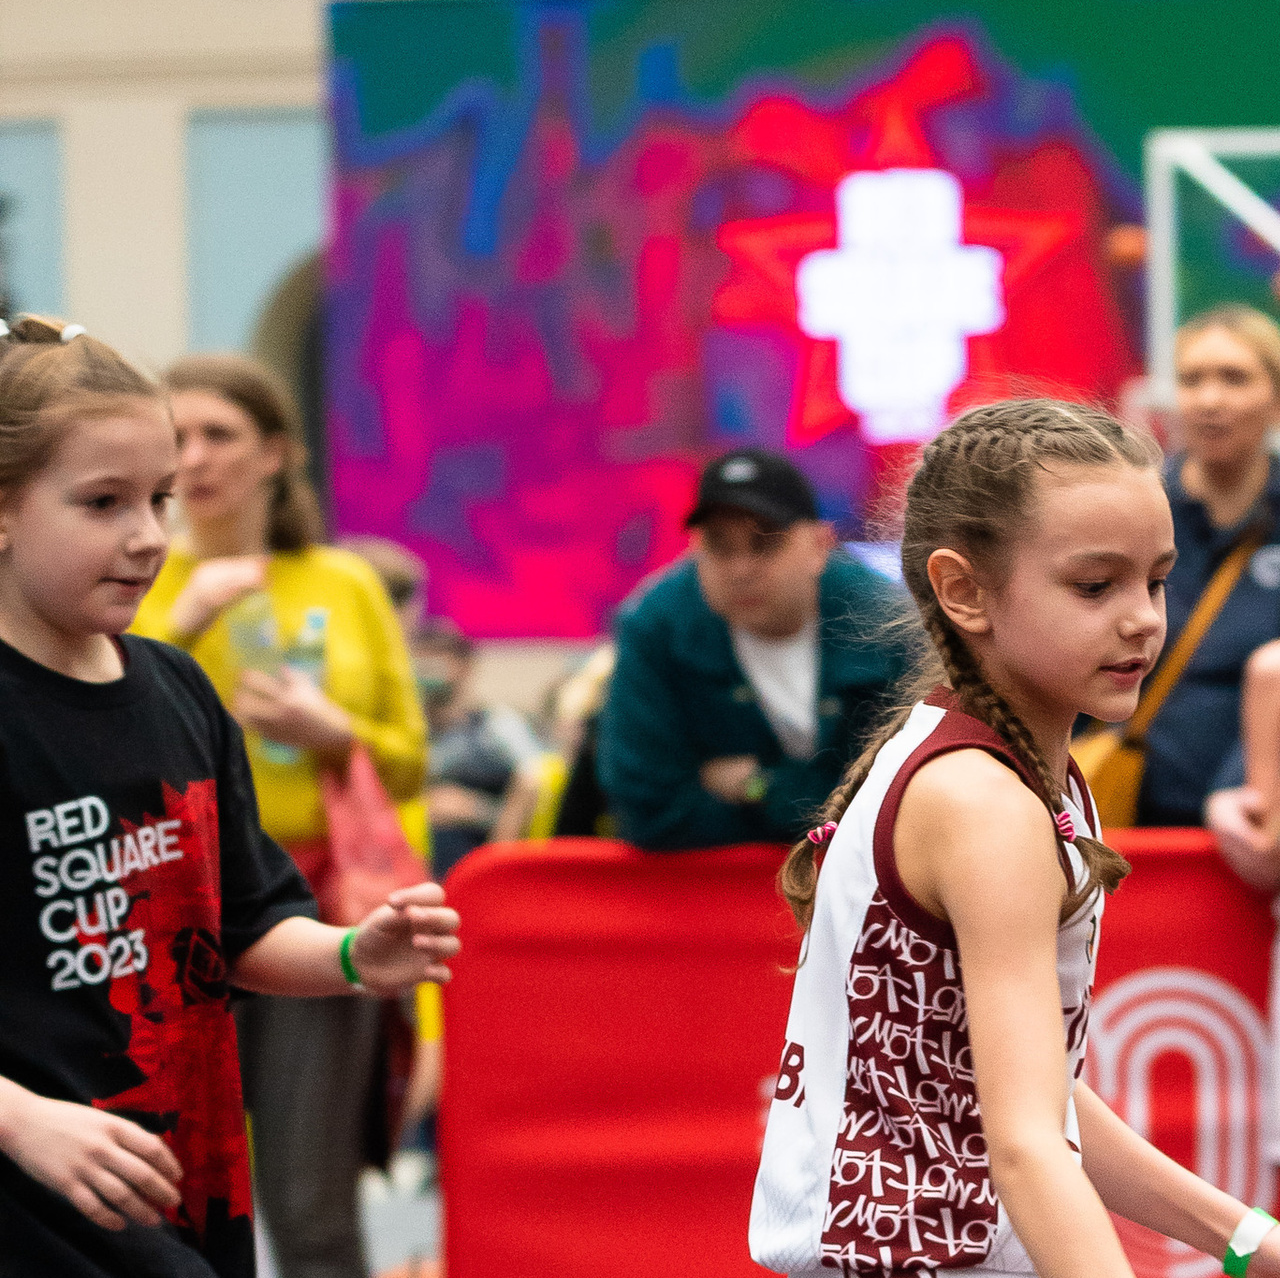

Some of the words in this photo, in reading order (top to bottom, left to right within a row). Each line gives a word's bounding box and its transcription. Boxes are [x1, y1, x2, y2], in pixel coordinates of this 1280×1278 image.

[25, 795, 110, 854] RED
[32, 818, 184, 898] SQUARE
[38, 887, 129, 944] CUP
[46, 928, 149, 992] 2023
